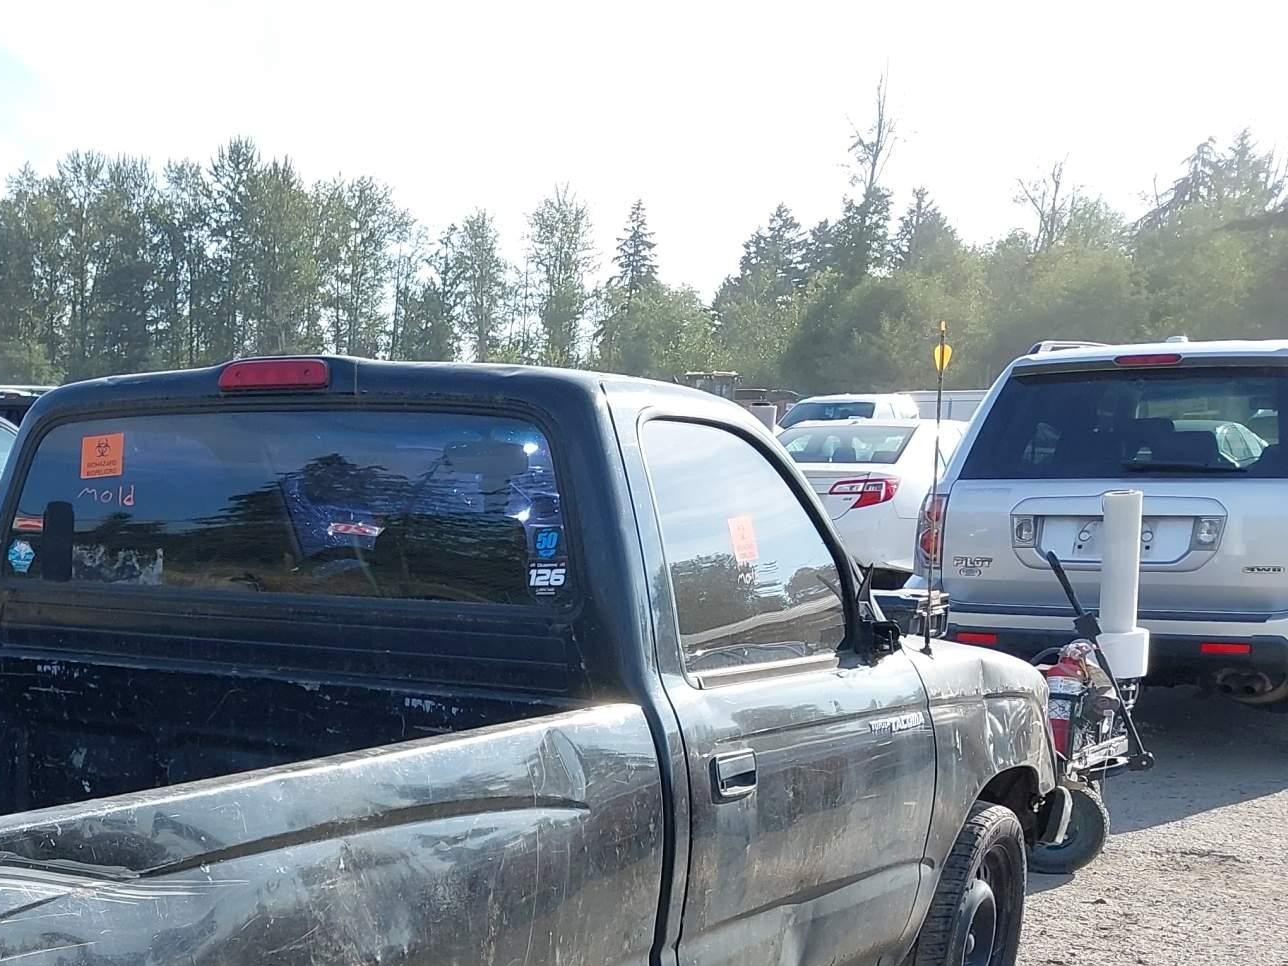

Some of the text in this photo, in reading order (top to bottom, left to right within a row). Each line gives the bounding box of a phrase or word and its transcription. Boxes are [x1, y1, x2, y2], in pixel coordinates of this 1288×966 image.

[536, 532, 559, 549] 50
[953, 556, 993, 568] PILOT
[529, 568, 567, 587] 126
